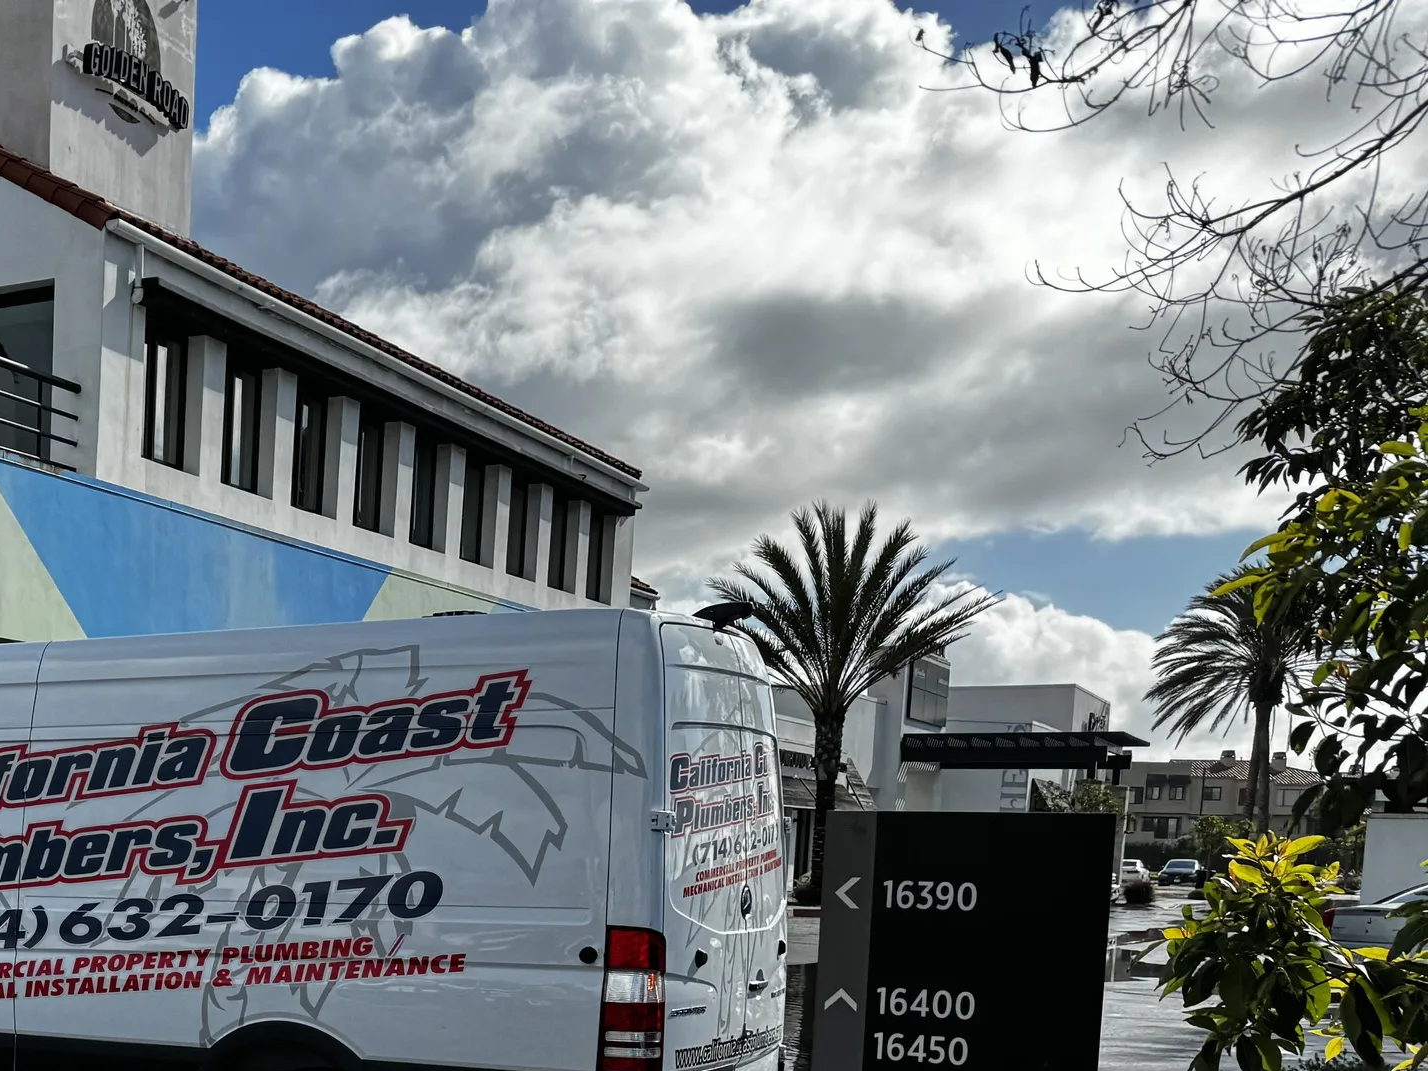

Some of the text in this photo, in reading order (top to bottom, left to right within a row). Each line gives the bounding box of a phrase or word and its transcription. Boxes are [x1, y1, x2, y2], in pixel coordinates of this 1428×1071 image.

[84, 42, 189, 129] GOLDEN ROAD
[221, 670, 528, 779] Coast
[670, 751, 752, 794] California
[225, 780, 413, 868] Inc.
[882, 879, 978, 911] 16390
[24, 971, 203, 998] INSTALLATION
[211, 967, 233, 987] &
[244, 953, 467, 985] MAINTENANCE
[72, 948, 212, 975] PROPERTY
[222, 936, 373, 964] PLUMBING
[876, 987, 975, 1020] 16400
[873, 1032, 968, 1066] 16450
